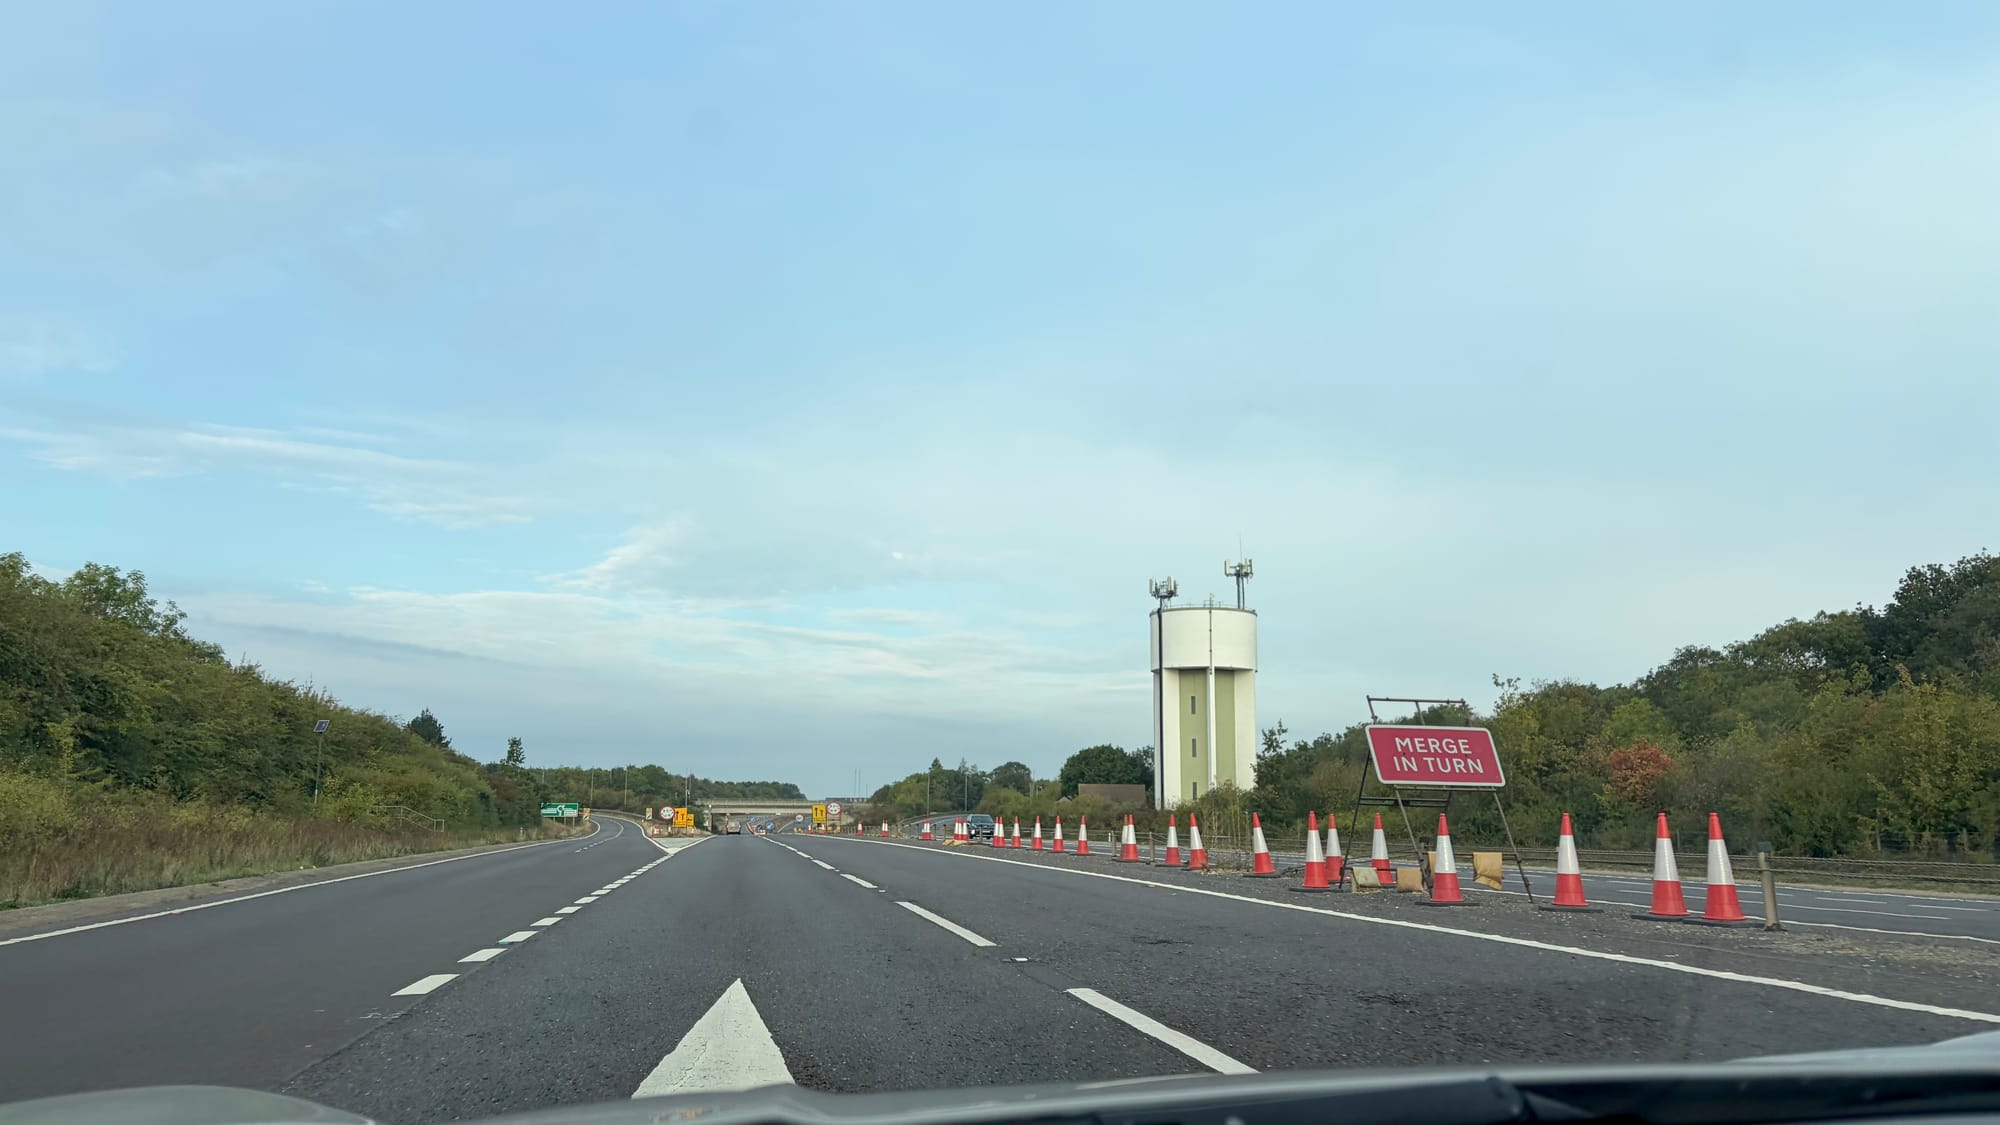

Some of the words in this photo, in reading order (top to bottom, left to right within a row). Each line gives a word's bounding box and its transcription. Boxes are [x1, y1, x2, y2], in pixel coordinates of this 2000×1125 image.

[1394, 737, 1472, 754] MERGE
[1393, 756, 1418, 772] IN
[1423, 757, 1484, 773] TURN
